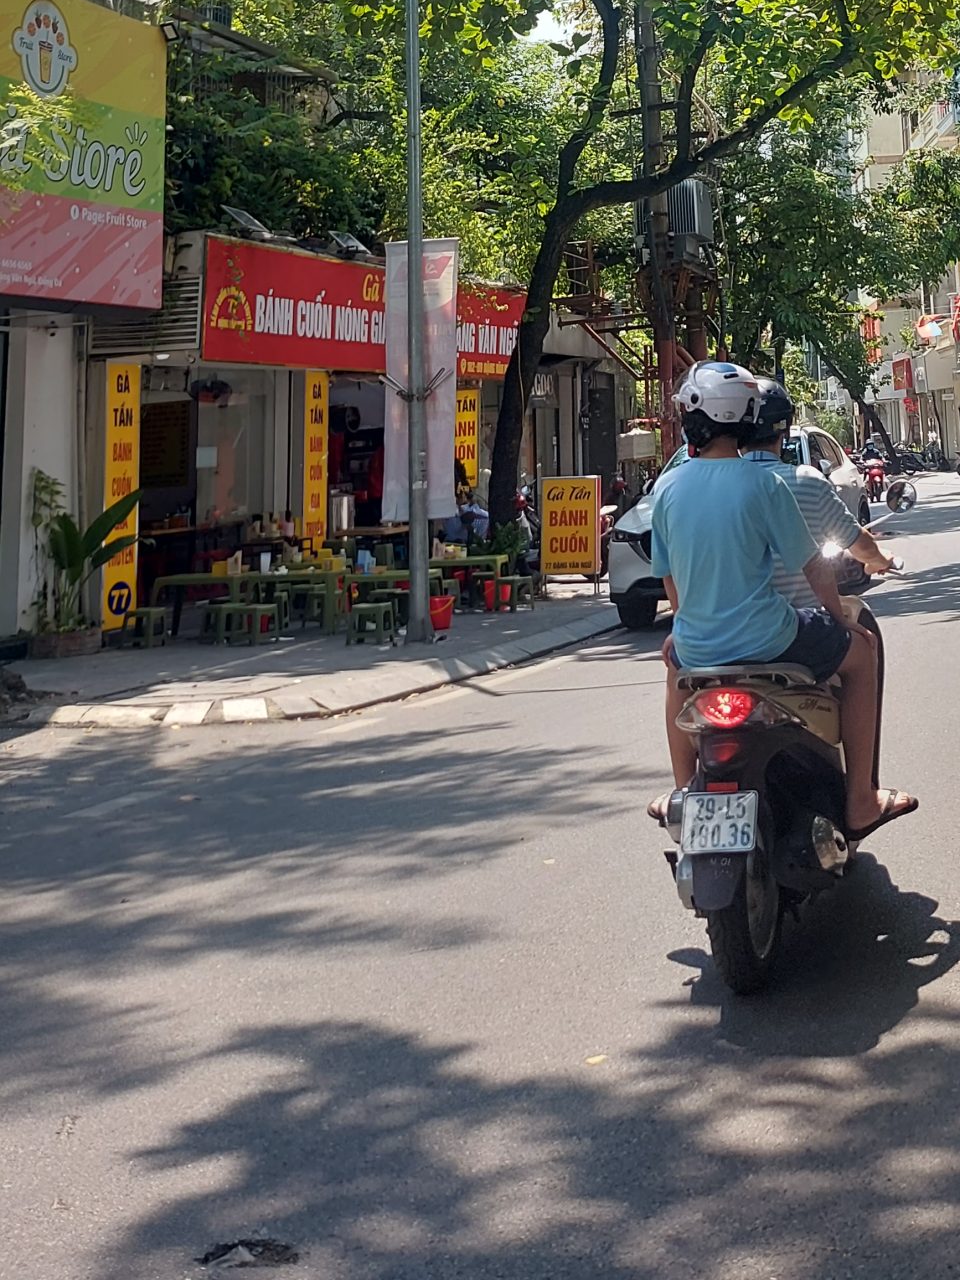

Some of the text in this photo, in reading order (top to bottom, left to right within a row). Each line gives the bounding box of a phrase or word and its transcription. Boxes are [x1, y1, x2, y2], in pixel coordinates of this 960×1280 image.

[43, 115, 147, 196] Store
[106, 211, 126, 227] Fruit
[126, 215, 148, 230] Store
[362, 273, 380, 301] Gà
[254, 288, 295, 336] BÁNH
[296, 290, 332, 340] CUỐN
[334, 299, 369, 343] NÓNG
[456, 314, 475, 358] ẶNG
[478, 319, 497, 355] VĂN
[455, 420, 476, 437] NH
[112, 439, 133, 462] BÁNH
[455, 439, 476, 461] ỐN
[547, 486, 564, 502] Gà
[549, 506, 588, 527] BÁNH
[550, 530, 589, 555] CUỐN
[110, 588, 129, 611] 77
